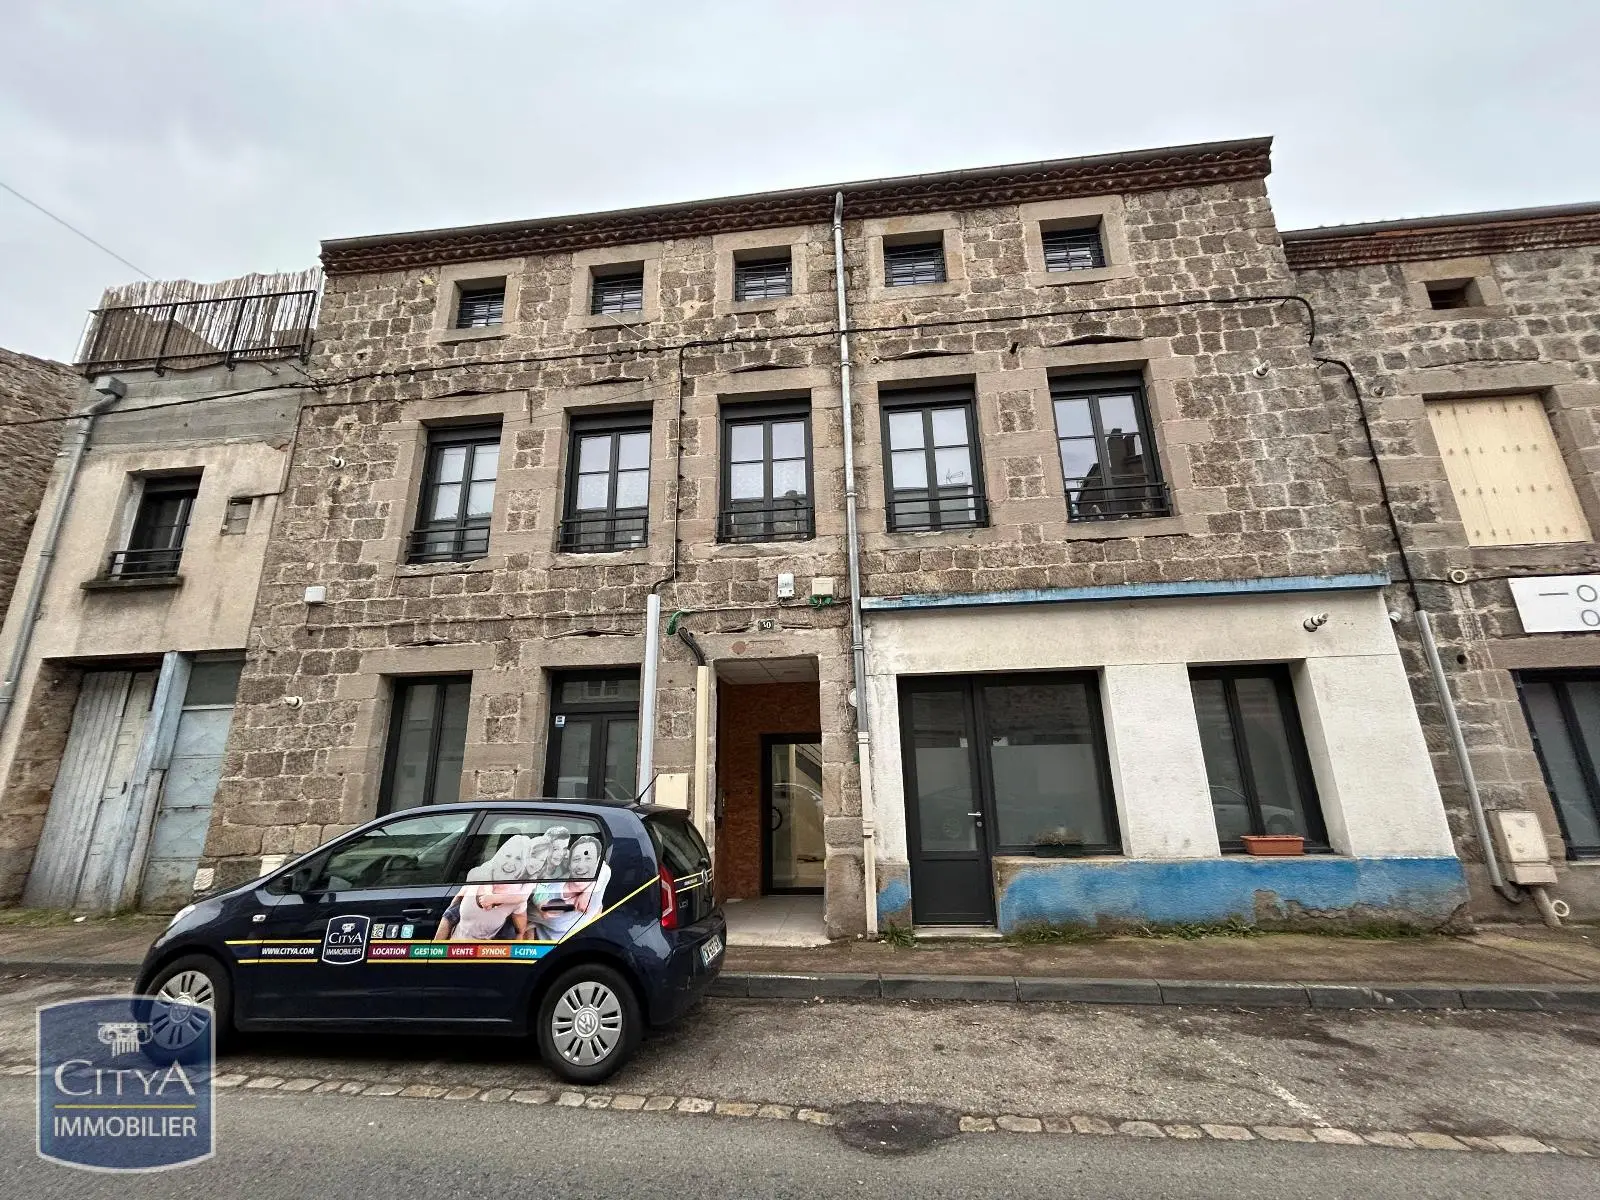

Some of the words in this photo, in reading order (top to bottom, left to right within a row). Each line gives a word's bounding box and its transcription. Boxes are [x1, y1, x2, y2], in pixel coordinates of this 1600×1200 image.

[762, 621, 771, 629] 10
[261, 947, 315, 955] WWW.CITYA.COM
[325, 947, 362, 956] IMMOBILIER
[372, 947, 407, 956] LOCATION
[414, 947, 444, 956] GESTION
[451, 947, 474, 956] VENTE
[481, 947, 507, 956] SYNDIC
